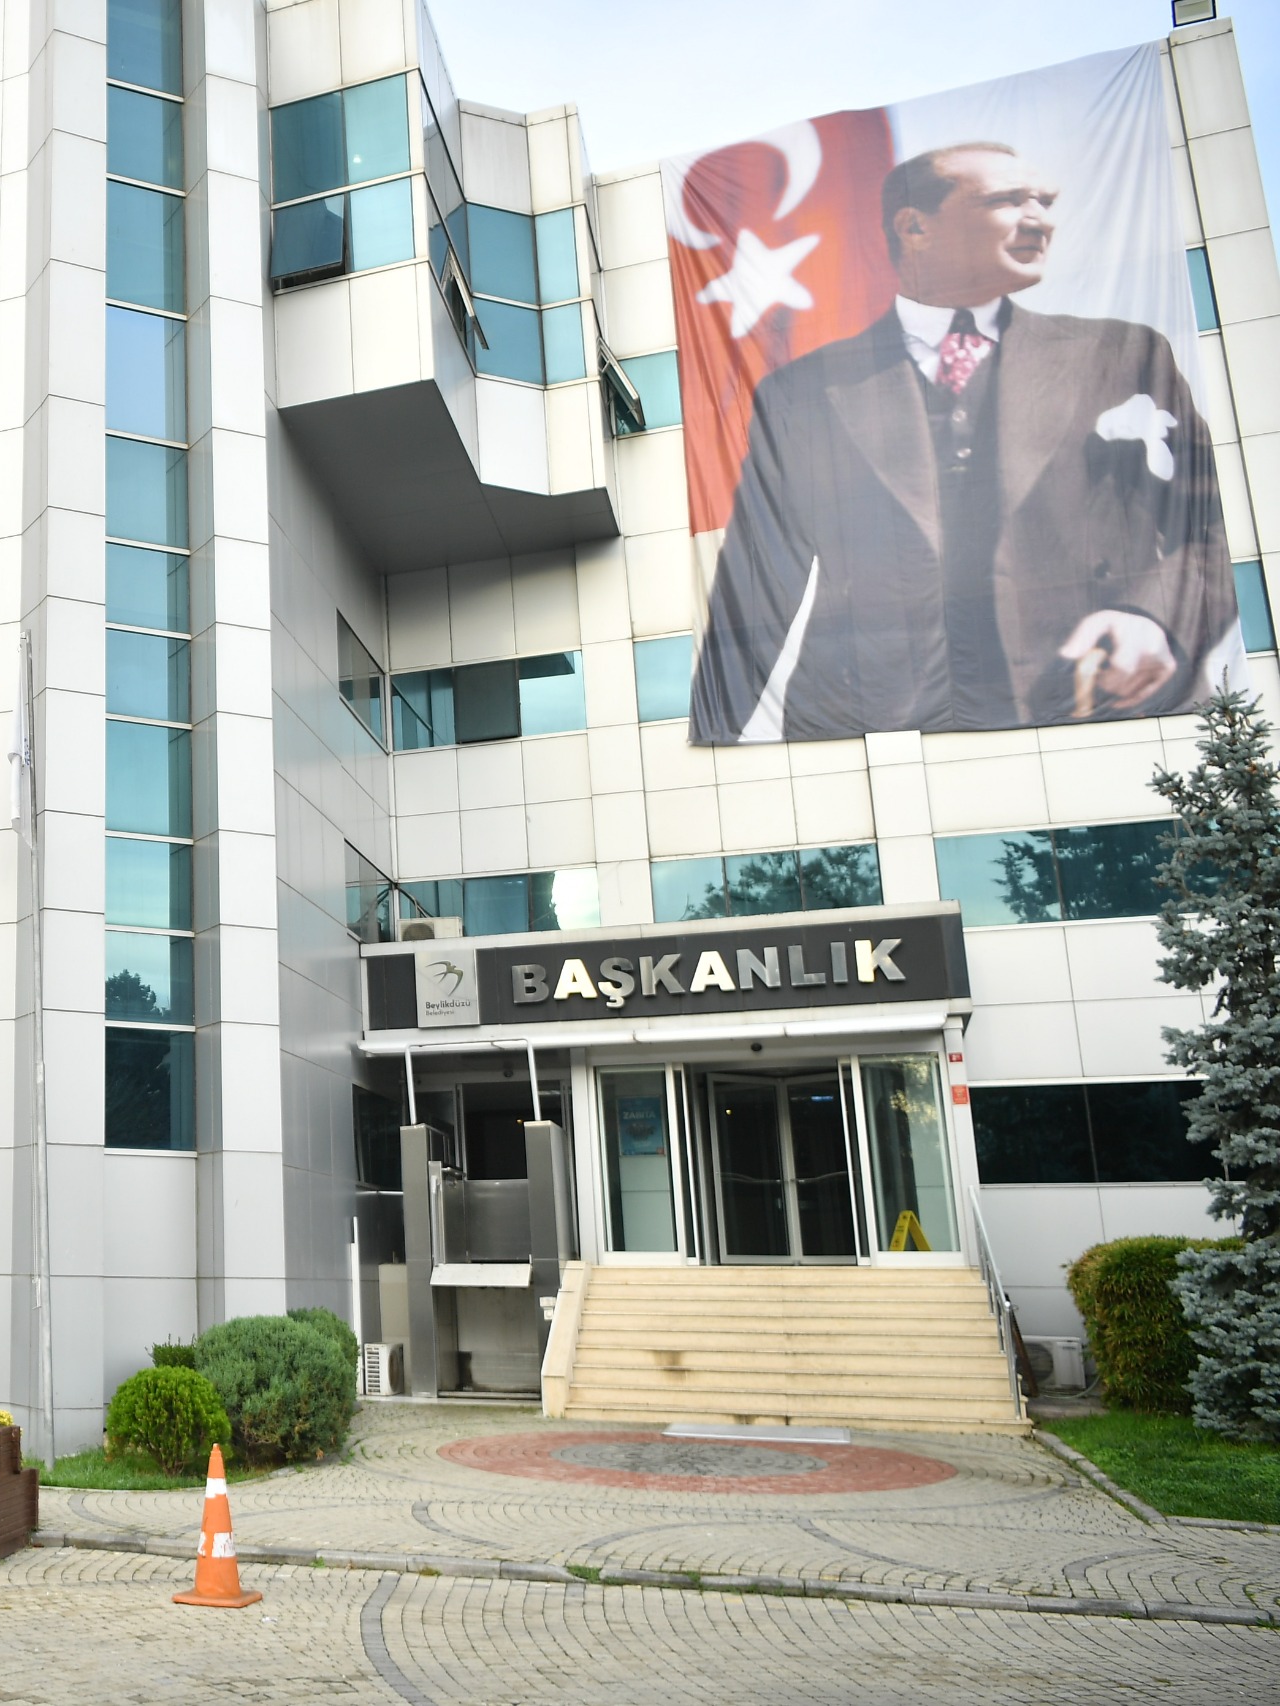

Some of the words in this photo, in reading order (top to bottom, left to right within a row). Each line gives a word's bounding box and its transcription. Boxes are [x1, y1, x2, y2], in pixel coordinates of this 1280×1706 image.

[511, 938, 907, 1009] BAŞKANLIK
[425, 999, 471, 1010] Beylikdüzü
[425, 1009, 455, 1017] Belediyesi
